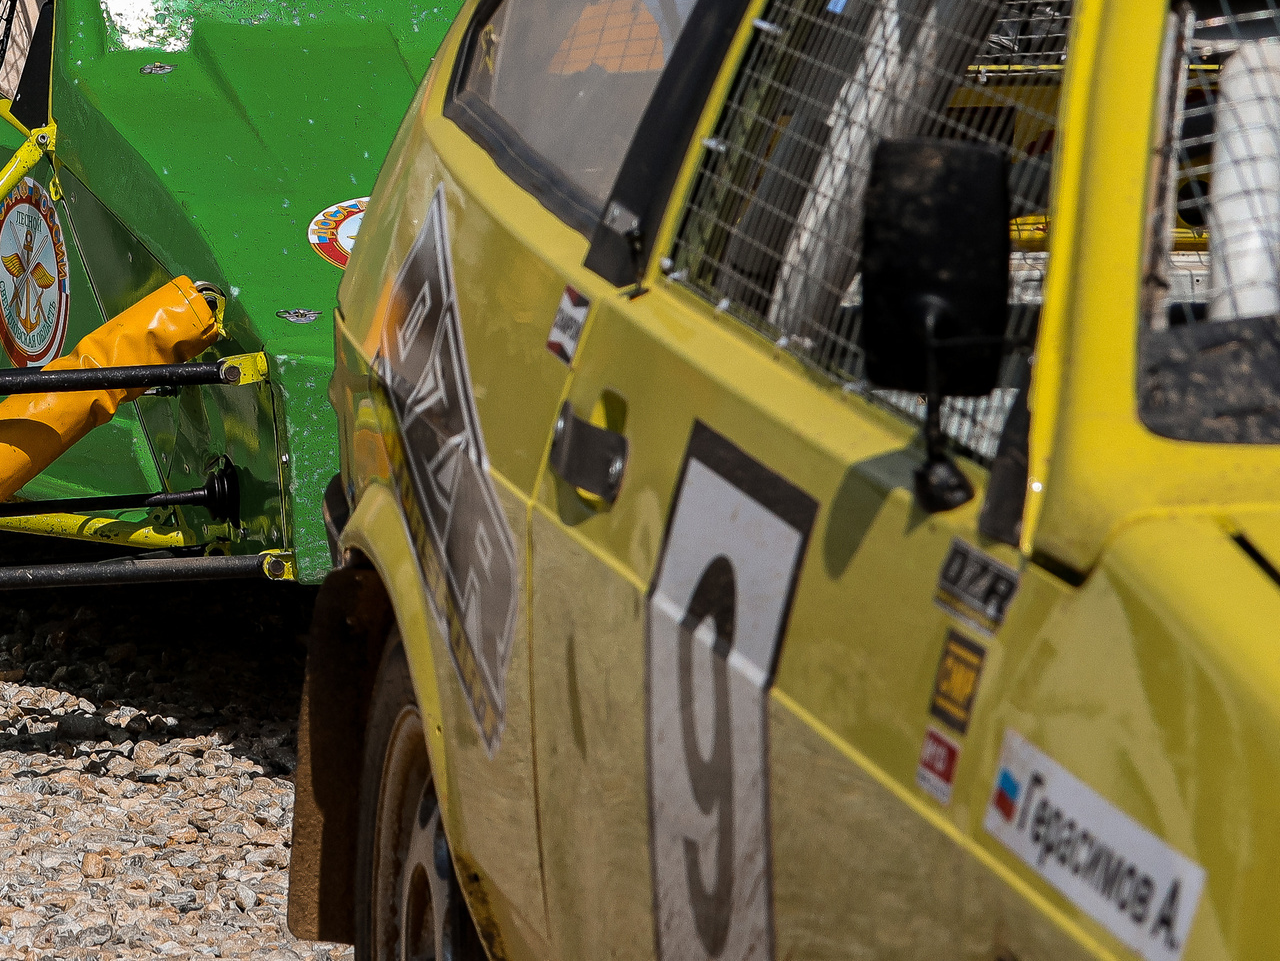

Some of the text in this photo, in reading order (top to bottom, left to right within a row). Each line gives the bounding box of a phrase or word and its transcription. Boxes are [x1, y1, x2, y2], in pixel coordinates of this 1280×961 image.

[16, 210, 43, 234] ЛЕСНОЙ
[31, 184, 68, 280] РОССИИ
[36, 300, 57, 347] ОБЛАСТЬ
[677, 553, 736, 959] 9
[1017, 770, 1182, 953] Герасимов А
